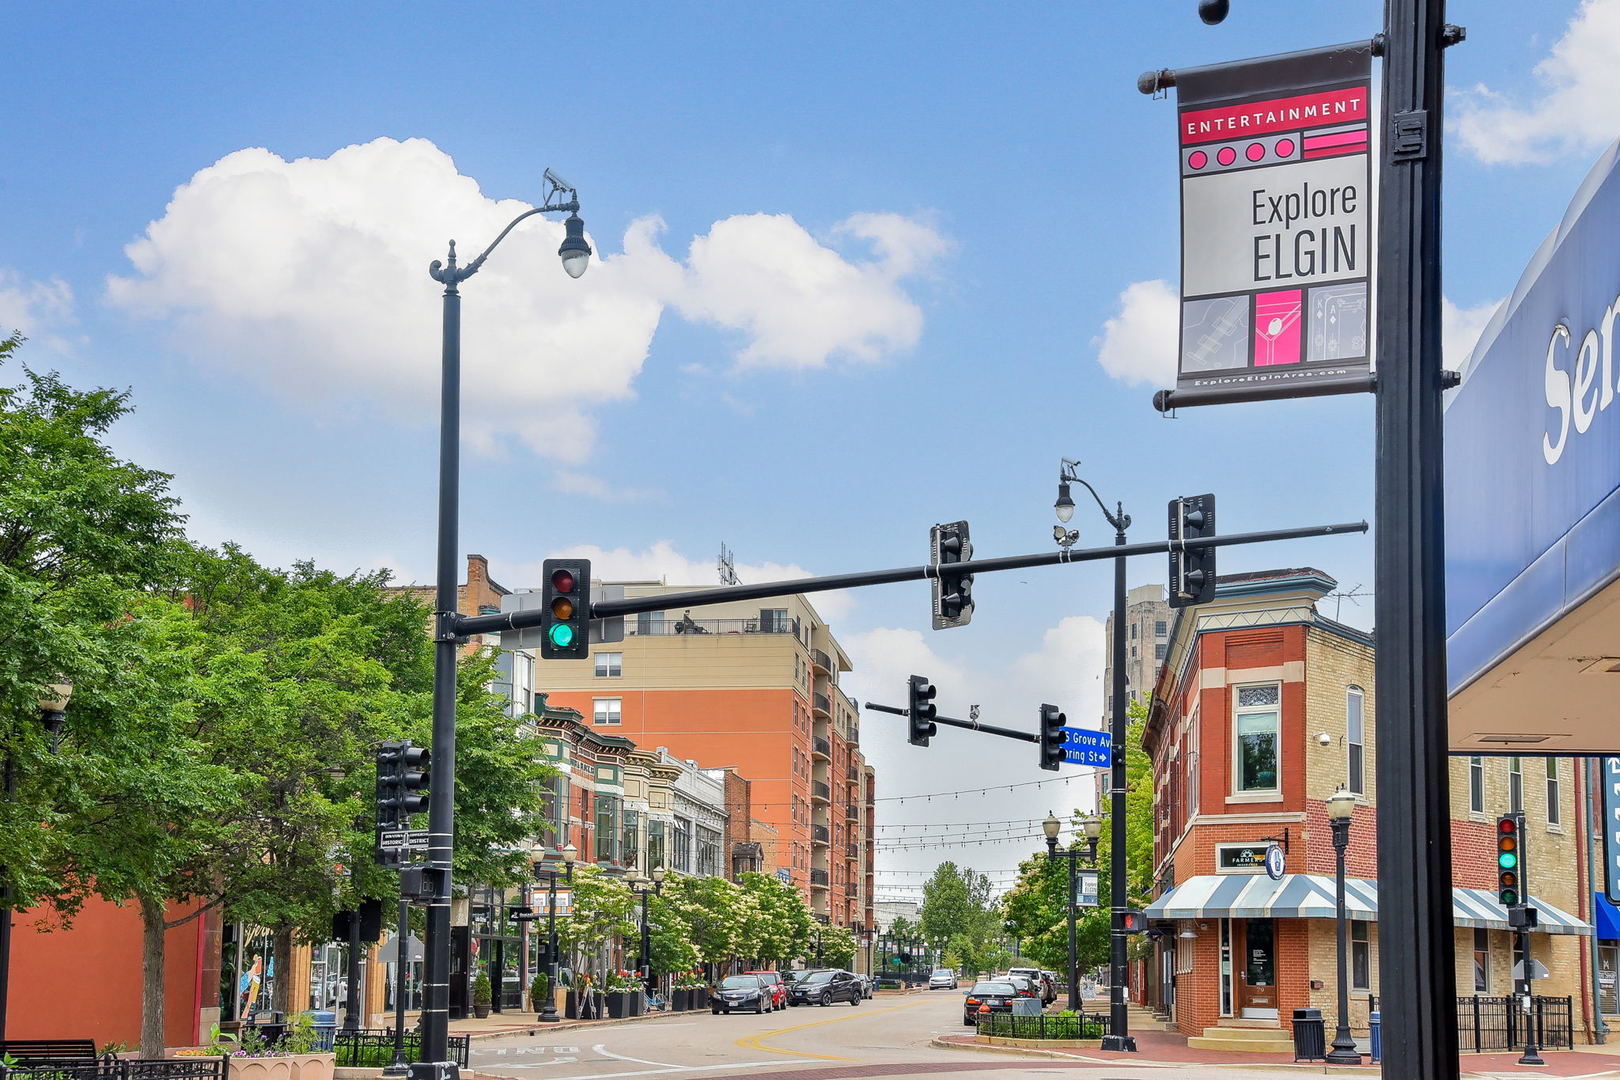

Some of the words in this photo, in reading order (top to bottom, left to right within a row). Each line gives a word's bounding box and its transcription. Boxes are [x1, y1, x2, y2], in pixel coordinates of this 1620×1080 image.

[1187, 98, 1361, 135] ENTERTAINMENT
[1252, 181, 1358, 230] Explore
[1253, 223, 1357, 282] ELGIN
[1194, 369, 1347, 386] ExploreElginArea.com
[1073, 732, 1097, 746] Grove
[1100, 736, 1110, 748] Av
[1066, 749, 1085, 764] ring
[1088, 751, 1098, 762] St
